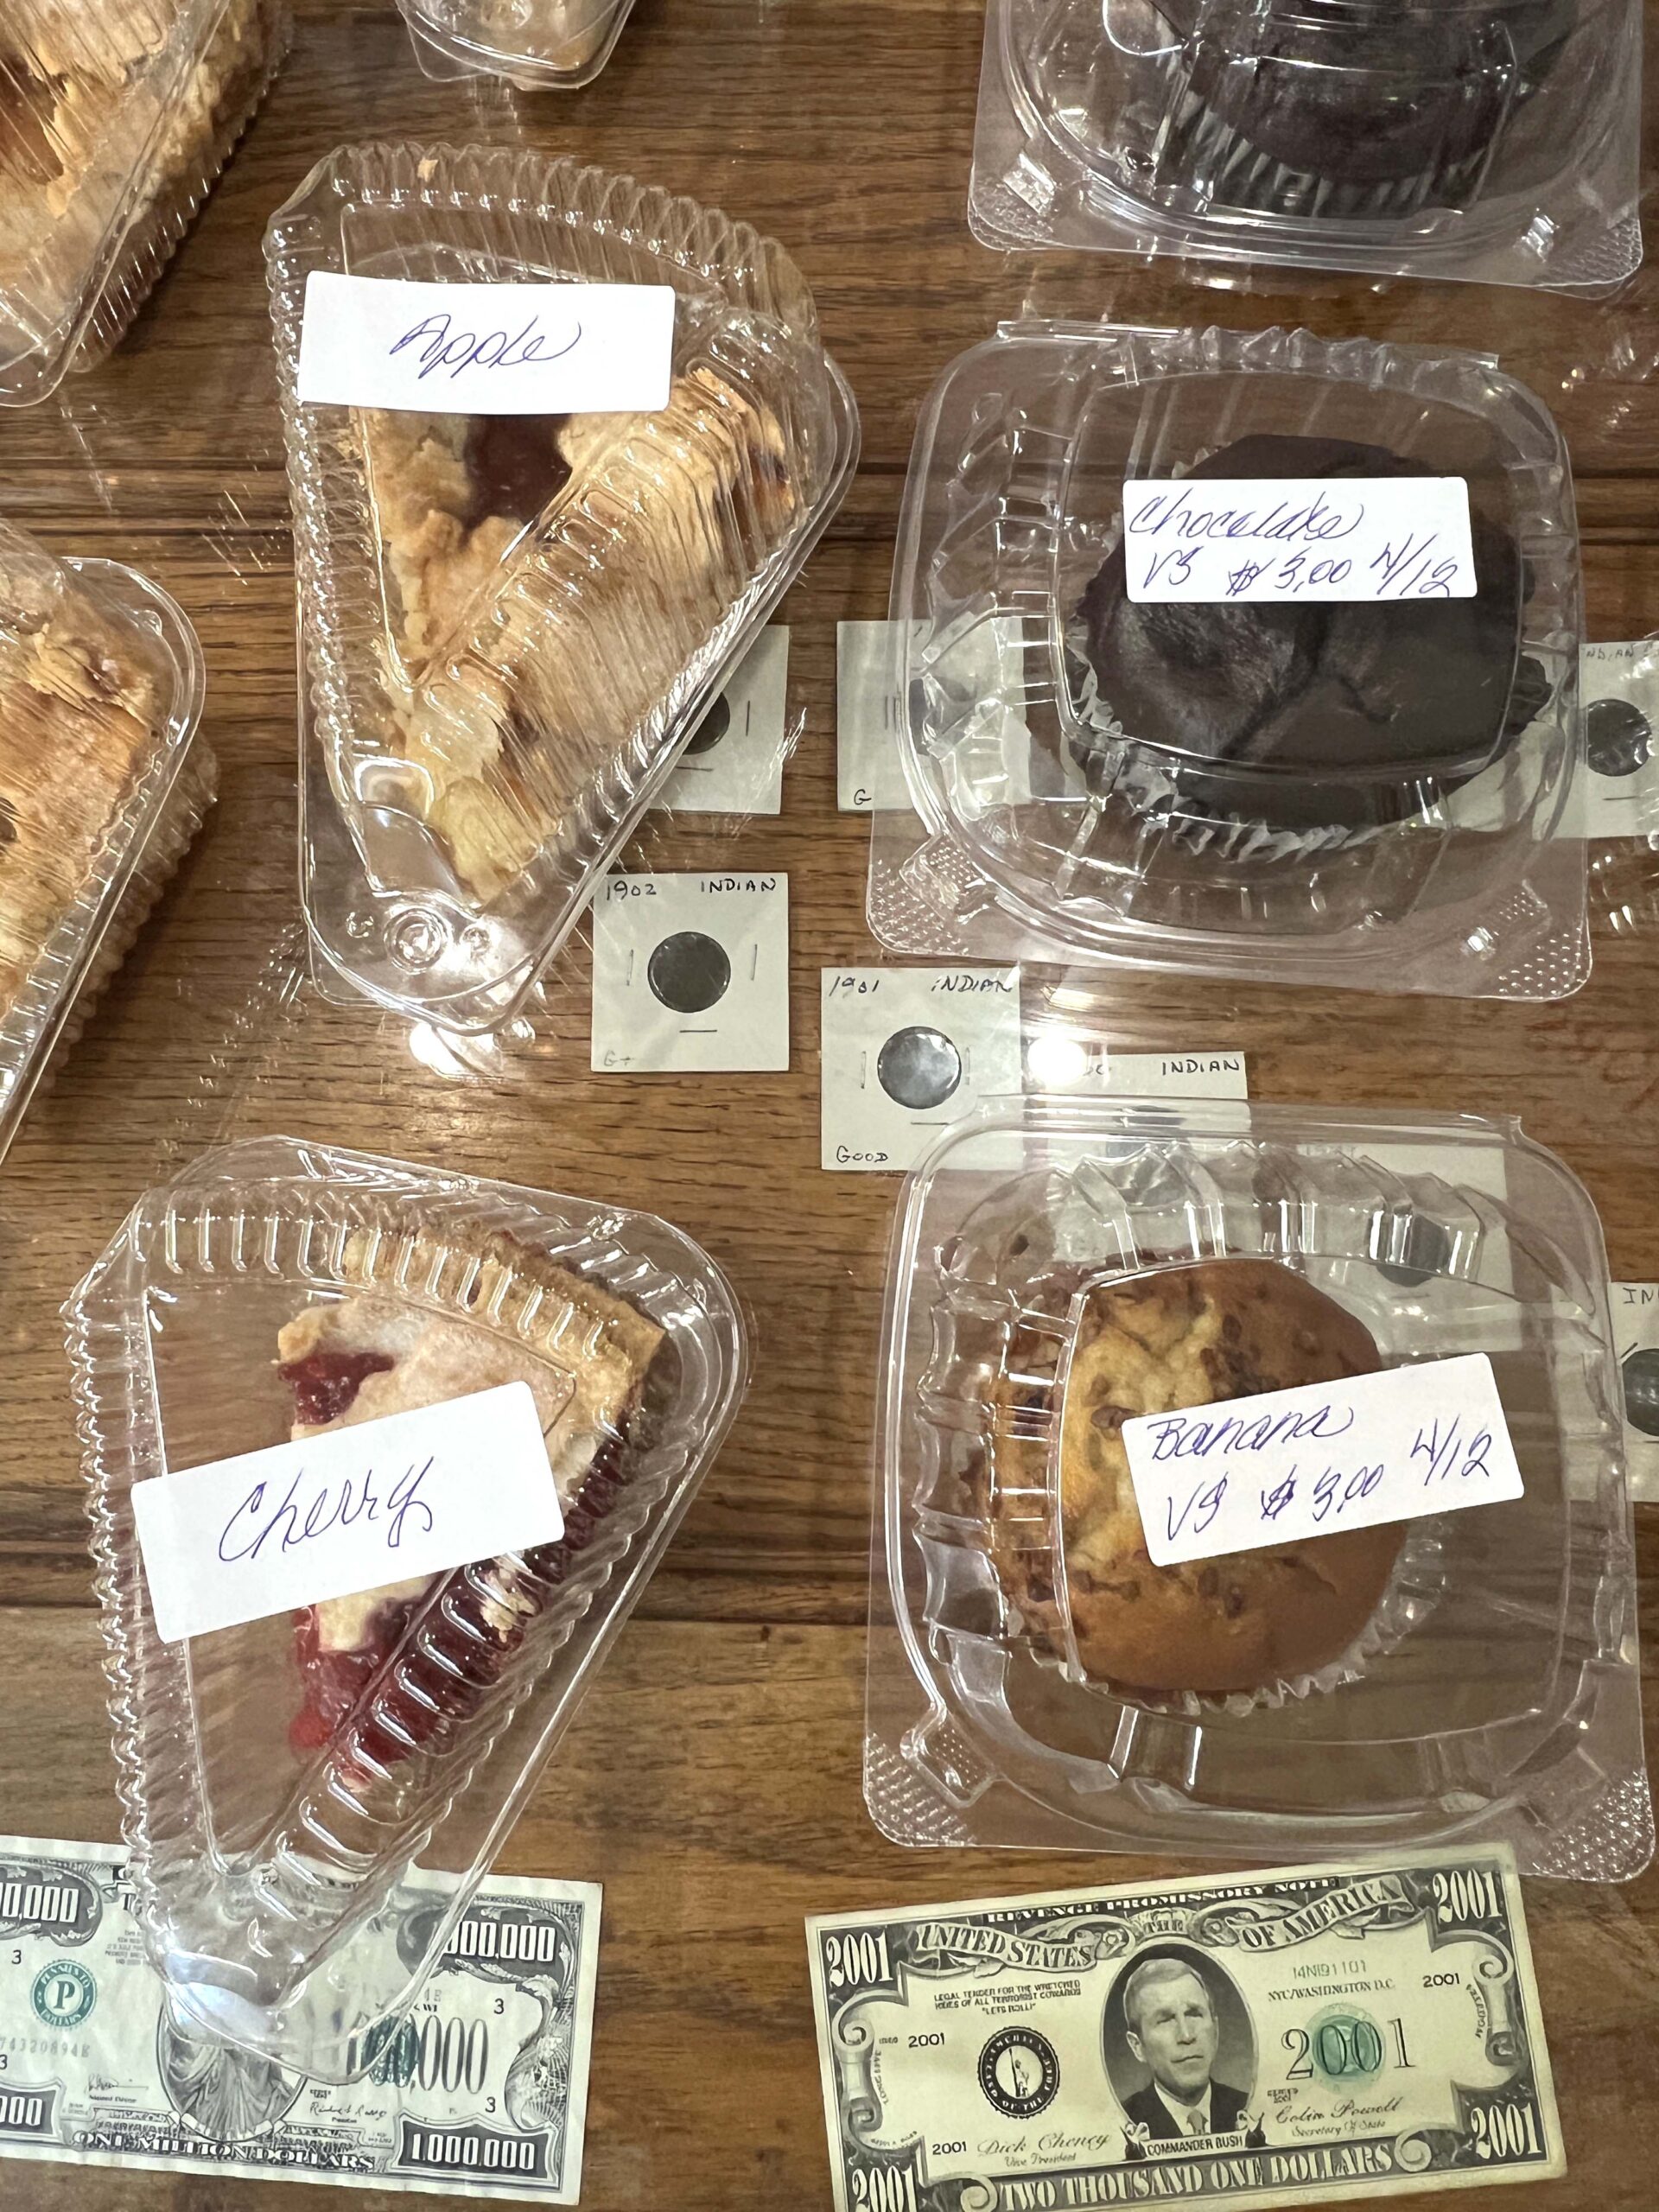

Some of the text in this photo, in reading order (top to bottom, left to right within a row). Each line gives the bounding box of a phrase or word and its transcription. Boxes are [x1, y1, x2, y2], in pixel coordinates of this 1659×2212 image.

[390, 315, 581, 378] Apple
[1129, 487, 1363, 540] Chocolate
[1370, 533, 1459, 597] 4/12
[606, 878, 776, 900] 1902 INDIAN
[931, 975, 1013, 993] INDIAN
[1162, 1058, 1240, 1076] INDIAN
[836, 1147, 888, 1164] GOOD
[1623, 1287, 1659, 1305] IN
[1147, 1405, 1354, 1460] Banana
[1410, 1414, 1492, 1486] 4/12
[219, 1456, 434, 1562] Cherry
[0, 1882, 79, 1923] 0,000
[1243, 1877, 1403, 1948] OF AMERICA
[1433, 1868, 1503, 1923] 2001
[11, 1949, 22, 1965] 3
[826, 1931, 893, 1986] 2001
[918, 1923, 1093, 1968] UNITED STATES
[53, 1980, 75, 2010] P
[1422, 1973, 1461, 1986] 2001
[493, 1998, 505, 2014] 3
[908, 2032, 944, 2049] 2001
[1281, 2017, 1416, 2081] 2001
[485, 2097, 496, 2113] 3
[932, 2141, 967, 2156] 2001
[977, 2133, 1111, 2156] Dick Cheney
[1147, 2135, 1243, 2156] COMMANDER BUSH
[1472, 2103, 1542, 2158] 2001
[852, 2165, 917, 2212] 2001
[1001, 2144, 1392, 2211] TWO THOUSAND ONE DOLLARS
